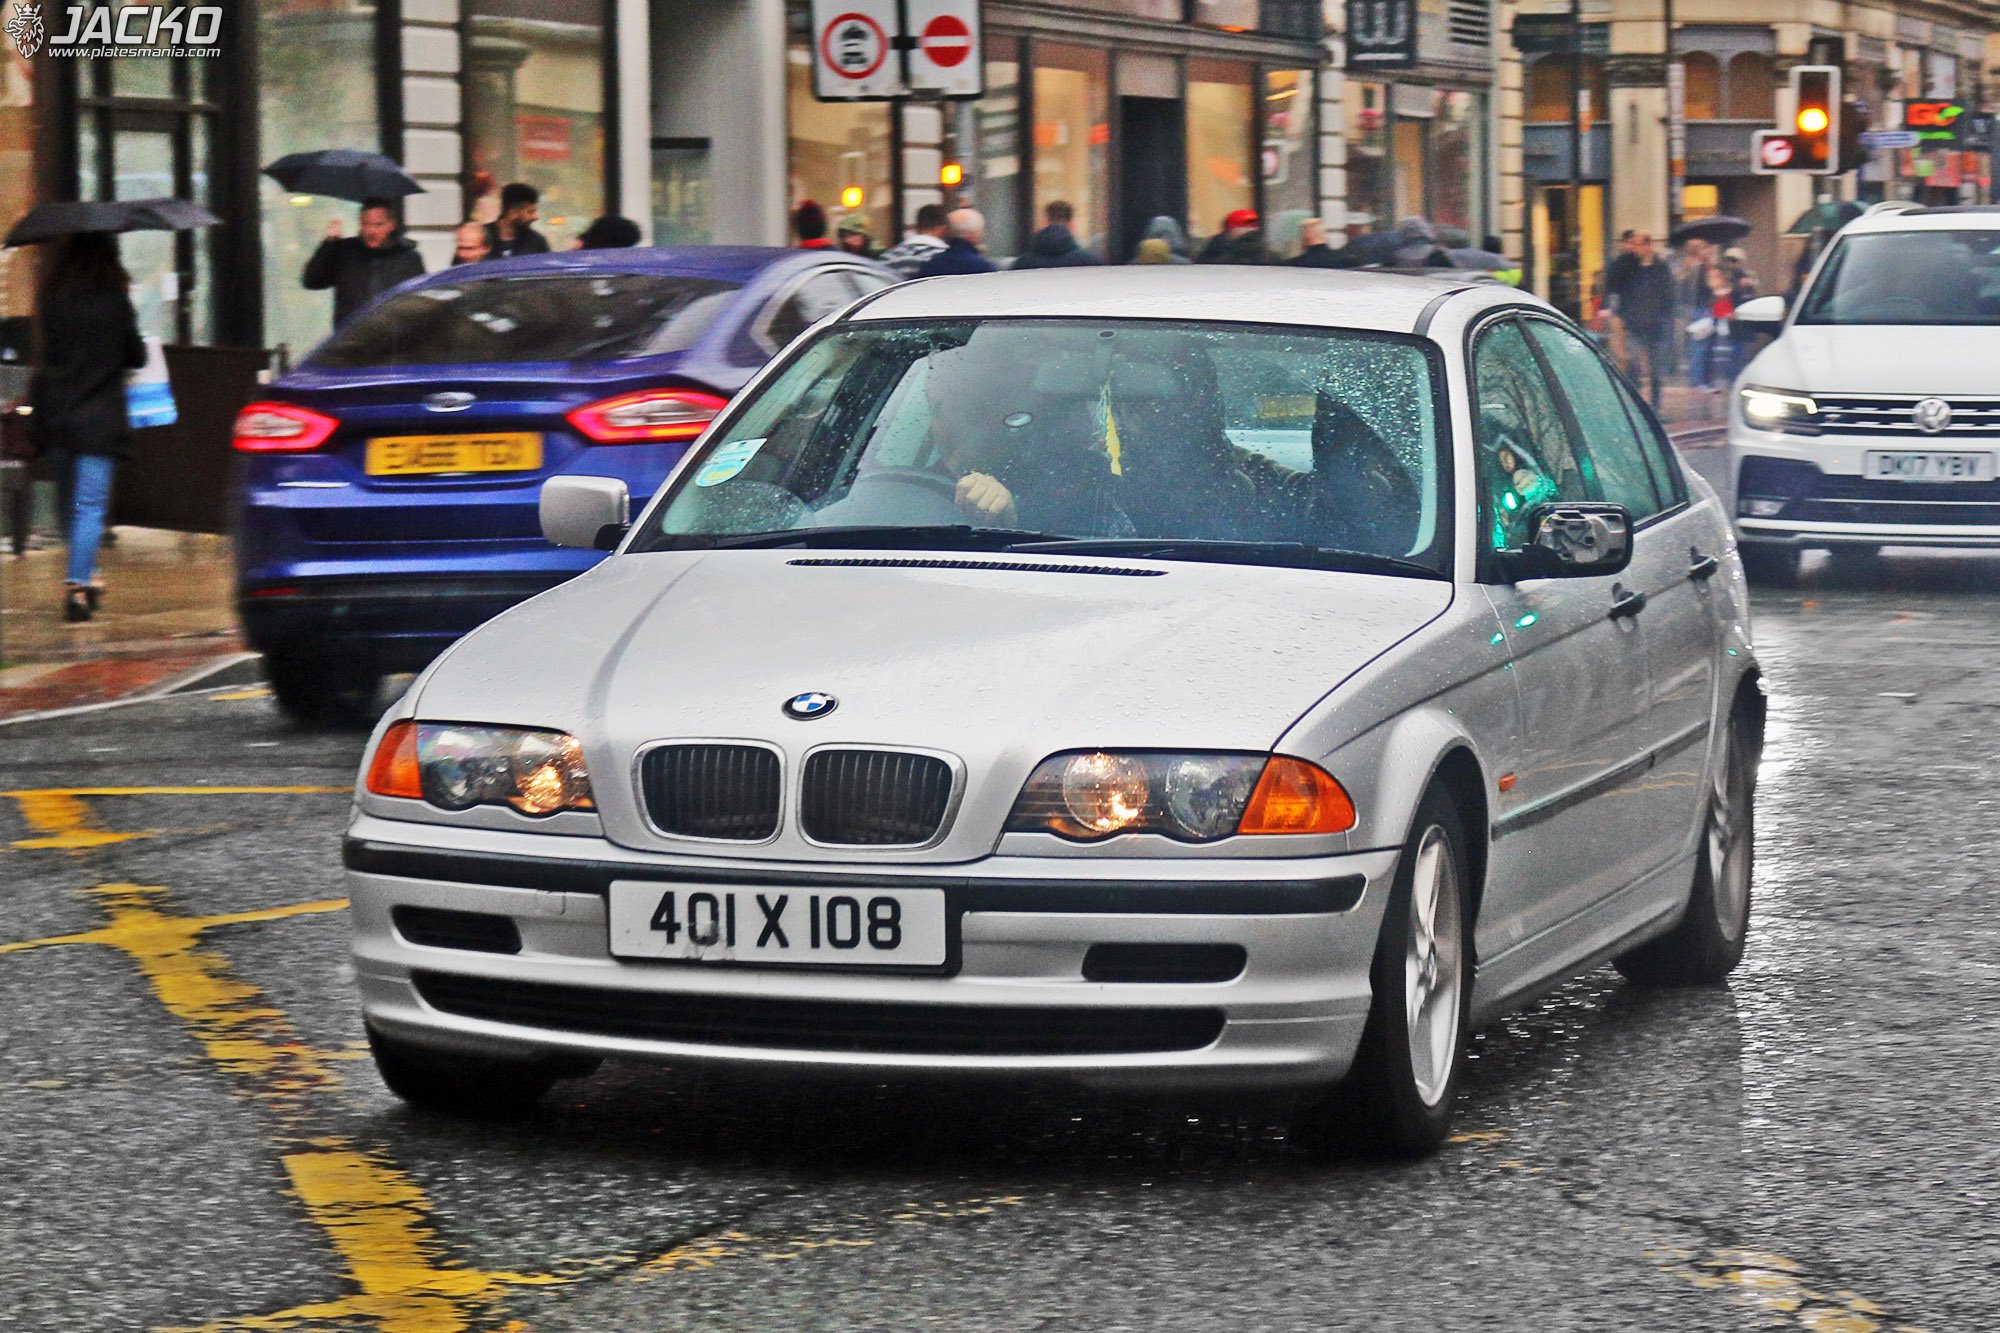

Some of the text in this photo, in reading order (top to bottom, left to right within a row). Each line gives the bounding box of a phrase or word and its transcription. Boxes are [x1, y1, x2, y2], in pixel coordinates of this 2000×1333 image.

[651, 891, 902, 950] 401 X 108
